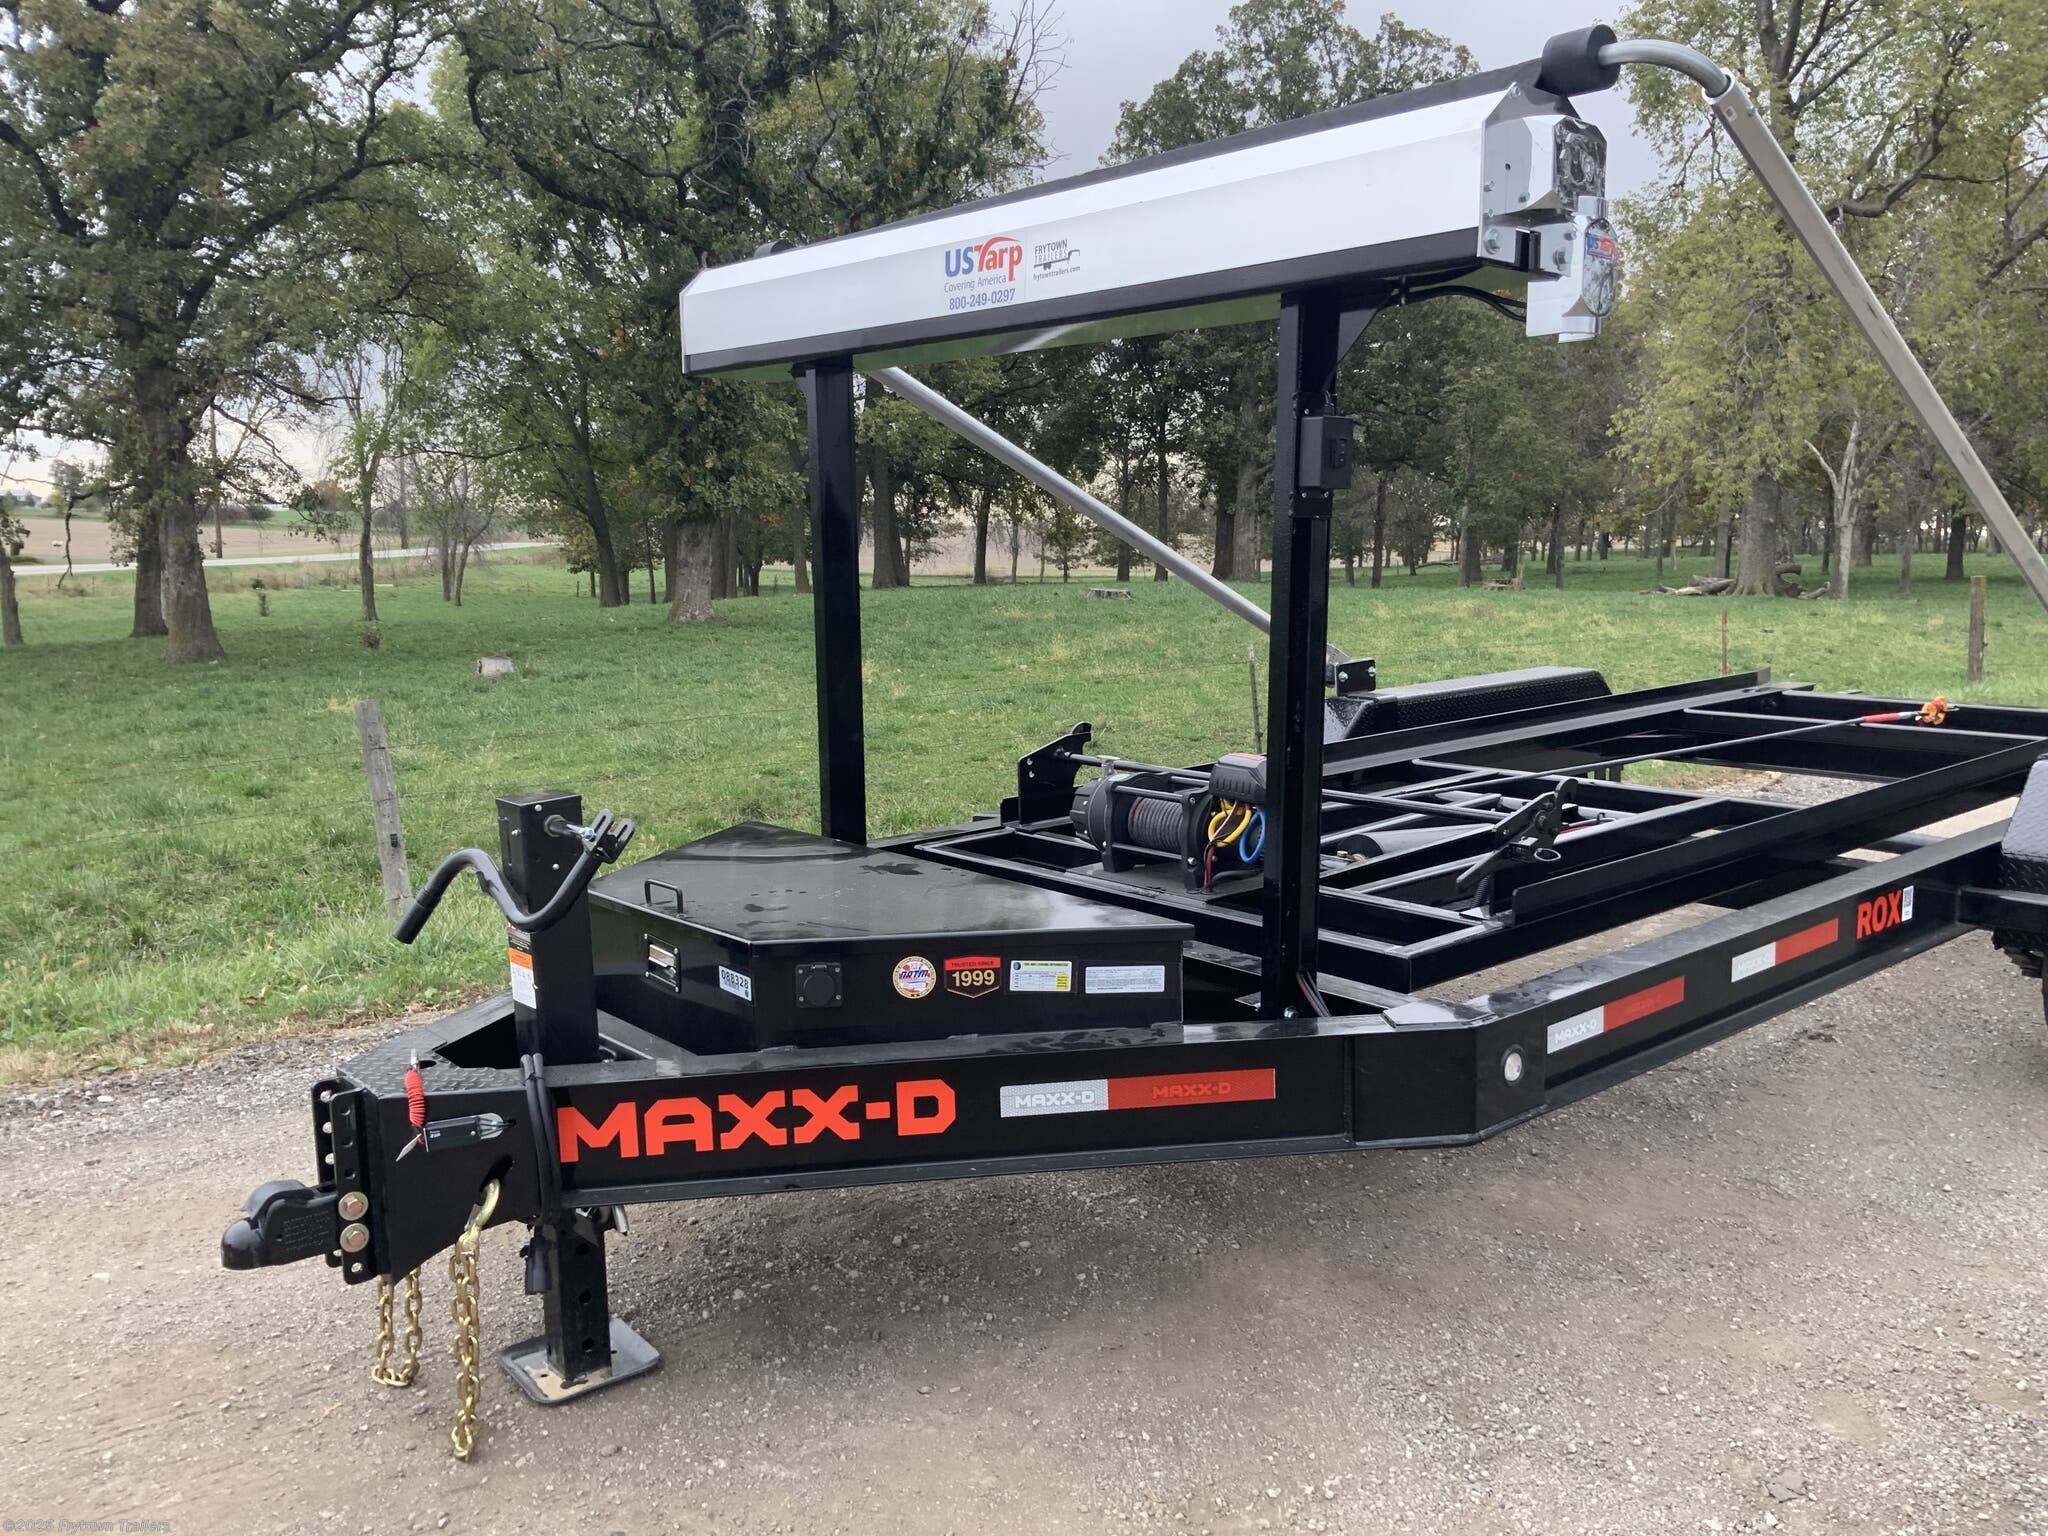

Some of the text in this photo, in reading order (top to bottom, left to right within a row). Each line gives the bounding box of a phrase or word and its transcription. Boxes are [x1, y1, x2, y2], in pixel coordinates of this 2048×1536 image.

[1034, 239, 1067, 254] FRYTOWN
[944, 273, 1007, 293] Covering America
[949, 288, 1016, 311] 800-249-0297
[1856, 889, 1902, 939] ROX
[721, 969, 749, 990] 088328
[952, 969, 995, 987] 1999
[1014, 1090, 1096, 1109] MAXX-D
[1152, 1082, 1231, 1099] MAXX-D
[557, 1079, 956, 1163] MAXX-D
